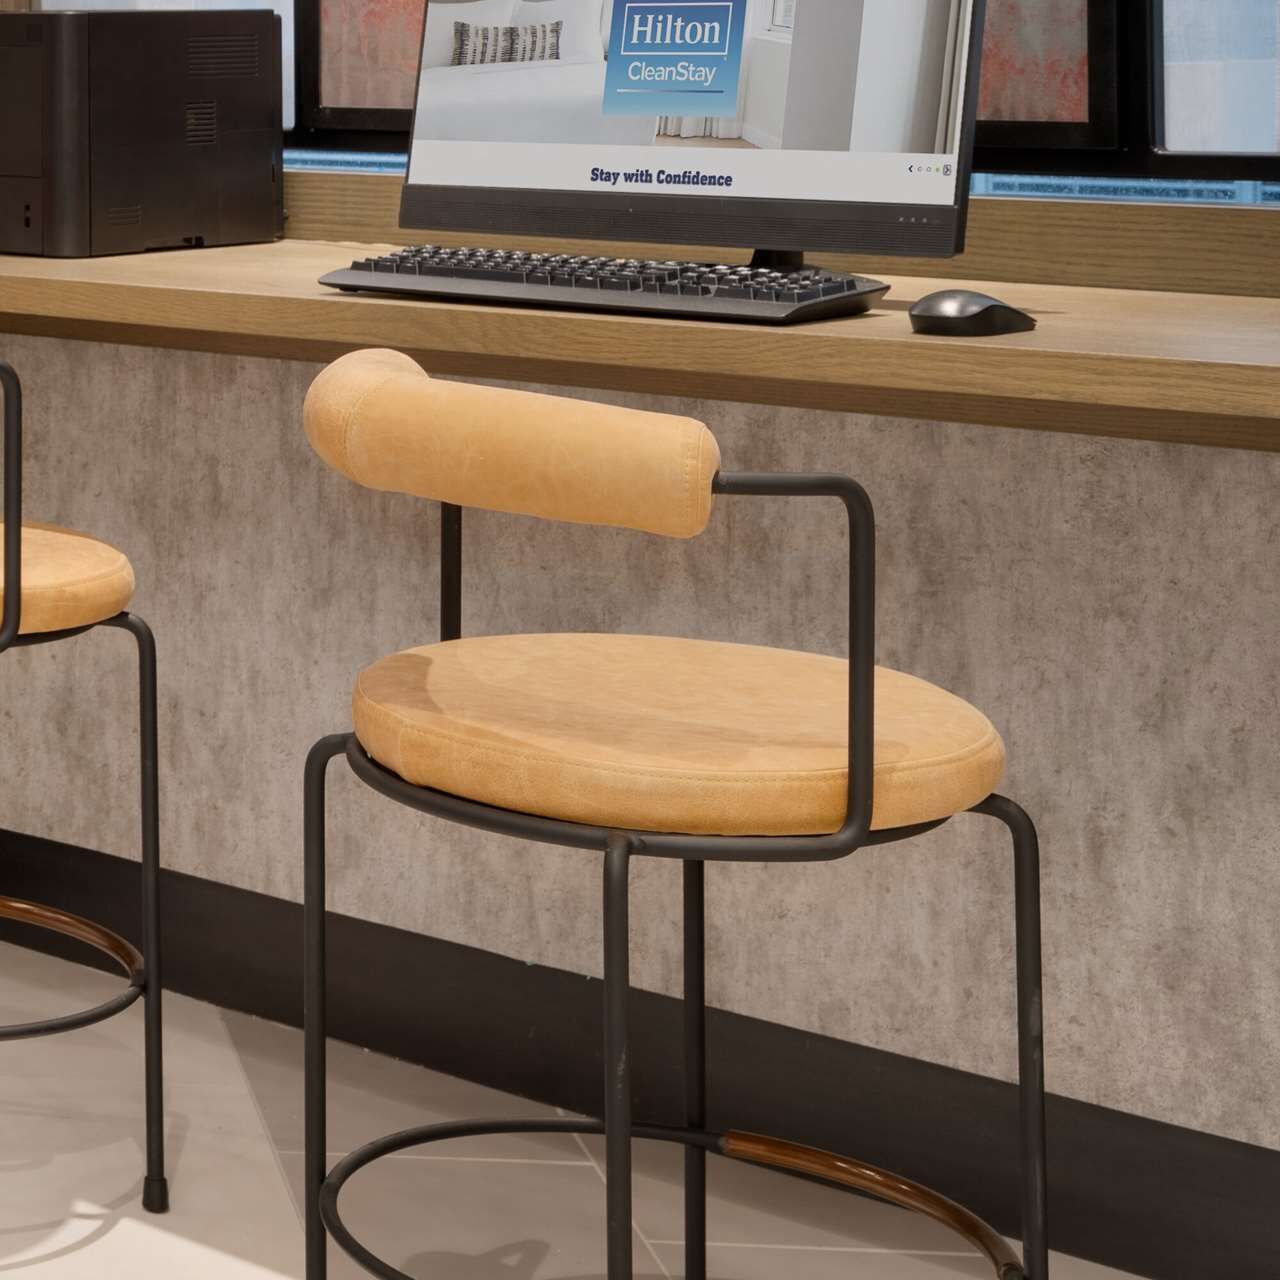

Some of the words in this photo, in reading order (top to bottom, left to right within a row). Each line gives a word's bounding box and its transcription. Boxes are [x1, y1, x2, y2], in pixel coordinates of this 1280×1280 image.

[630, 14, 721, 45] Hilton
[627, 61, 718, 87] CleanStay
[591, 167, 620, 186] Stay
[624, 169, 653, 184] with
[656, 170, 734, 187] Confidence
